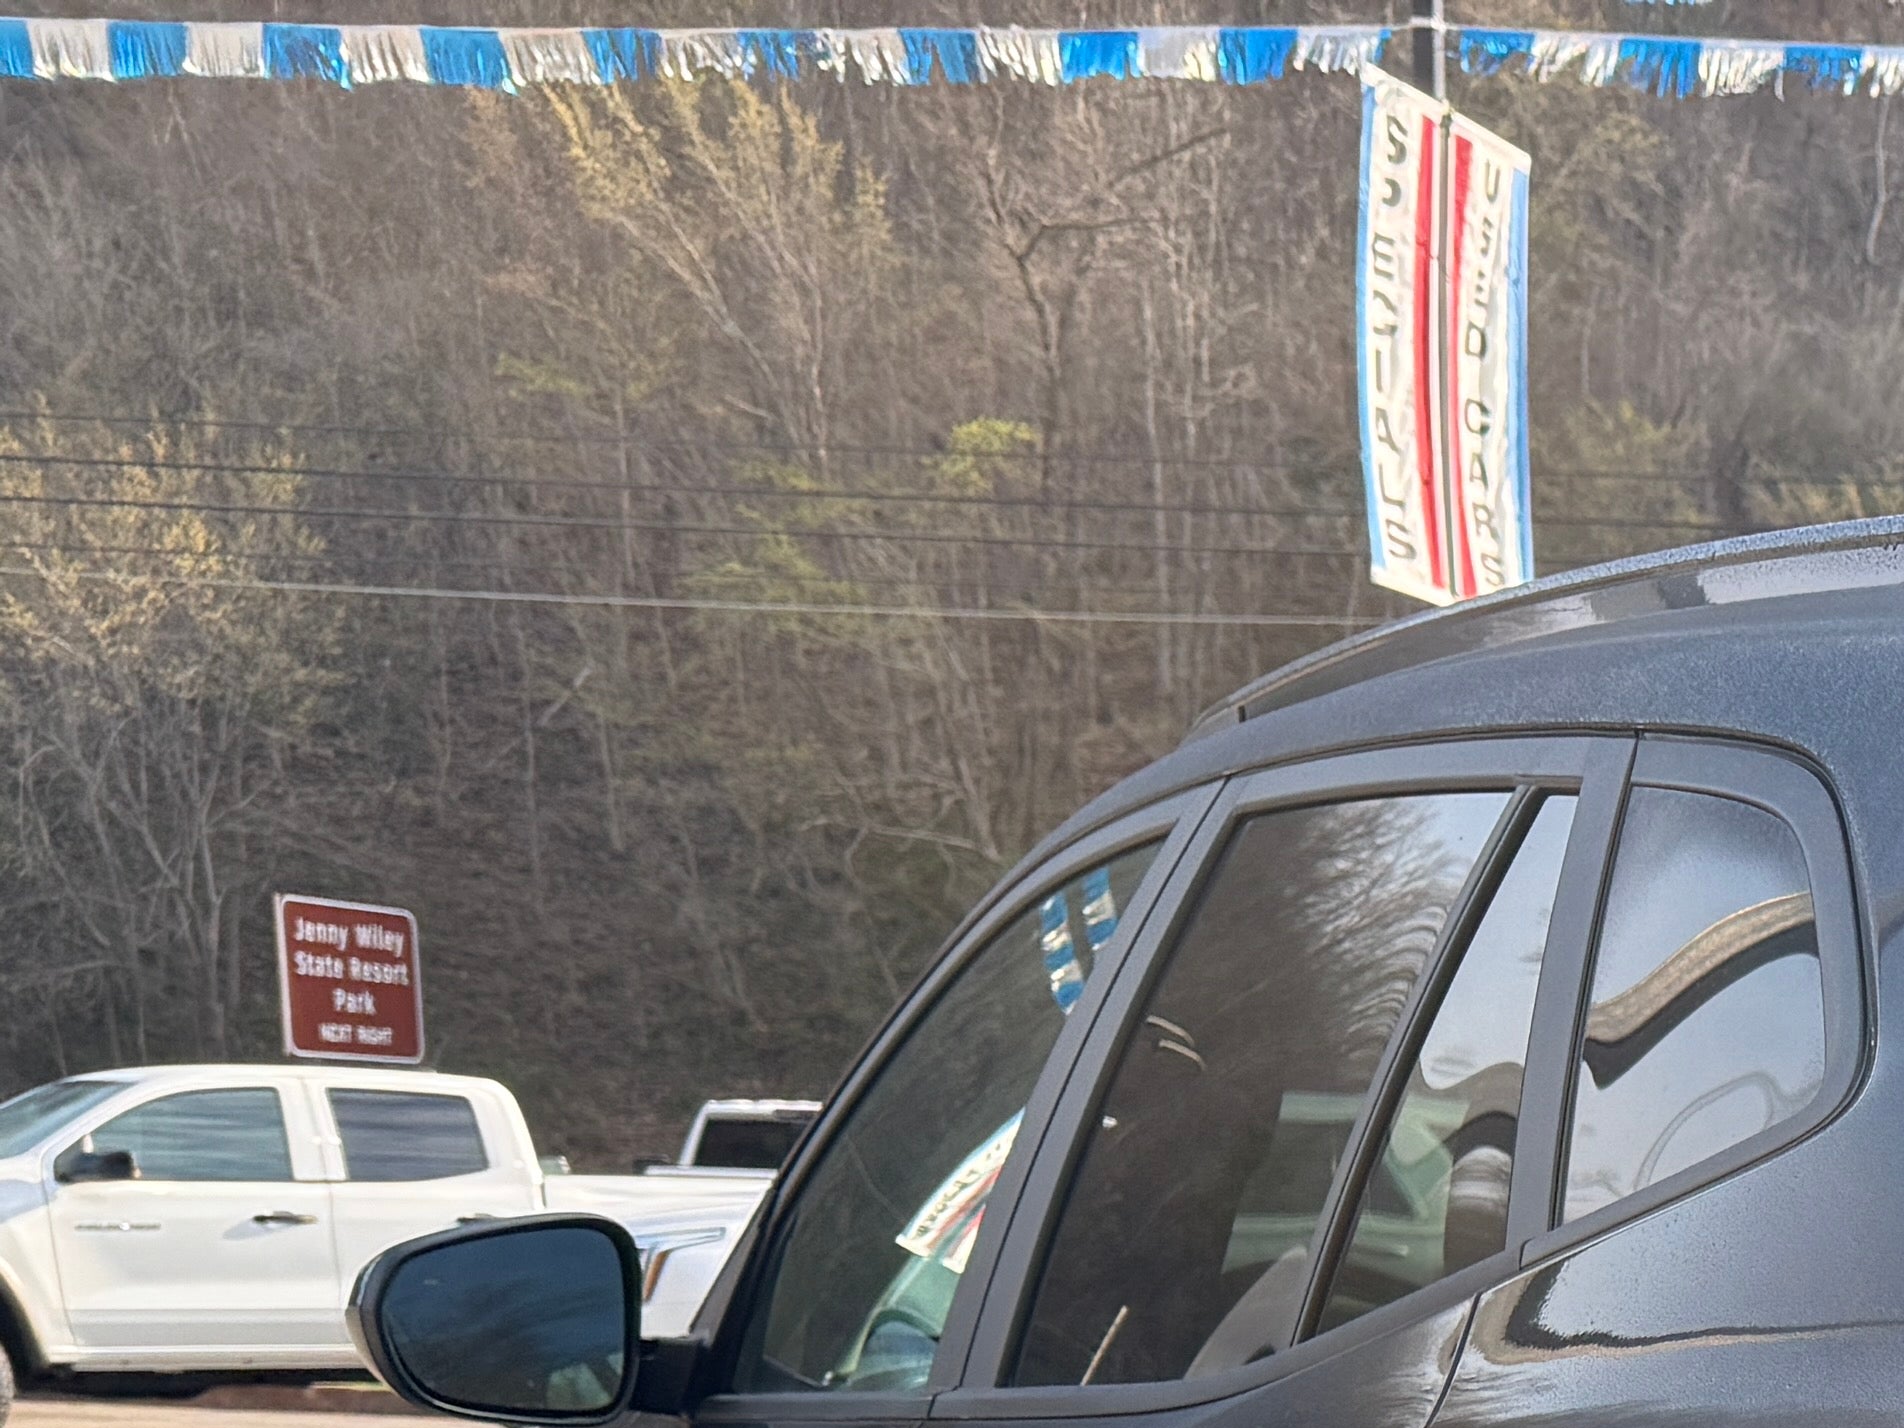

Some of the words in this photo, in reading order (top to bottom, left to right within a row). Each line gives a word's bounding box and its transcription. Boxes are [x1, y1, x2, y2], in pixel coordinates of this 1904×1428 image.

[1464, 396, 1506, 588] CARS
[294, 916, 349, 951] Jenny
[354, 923, 404, 958] Wiley
[294, 950, 344, 979] State
[348, 957, 409, 986] Resort
[332, 987, 377, 1016] Park
